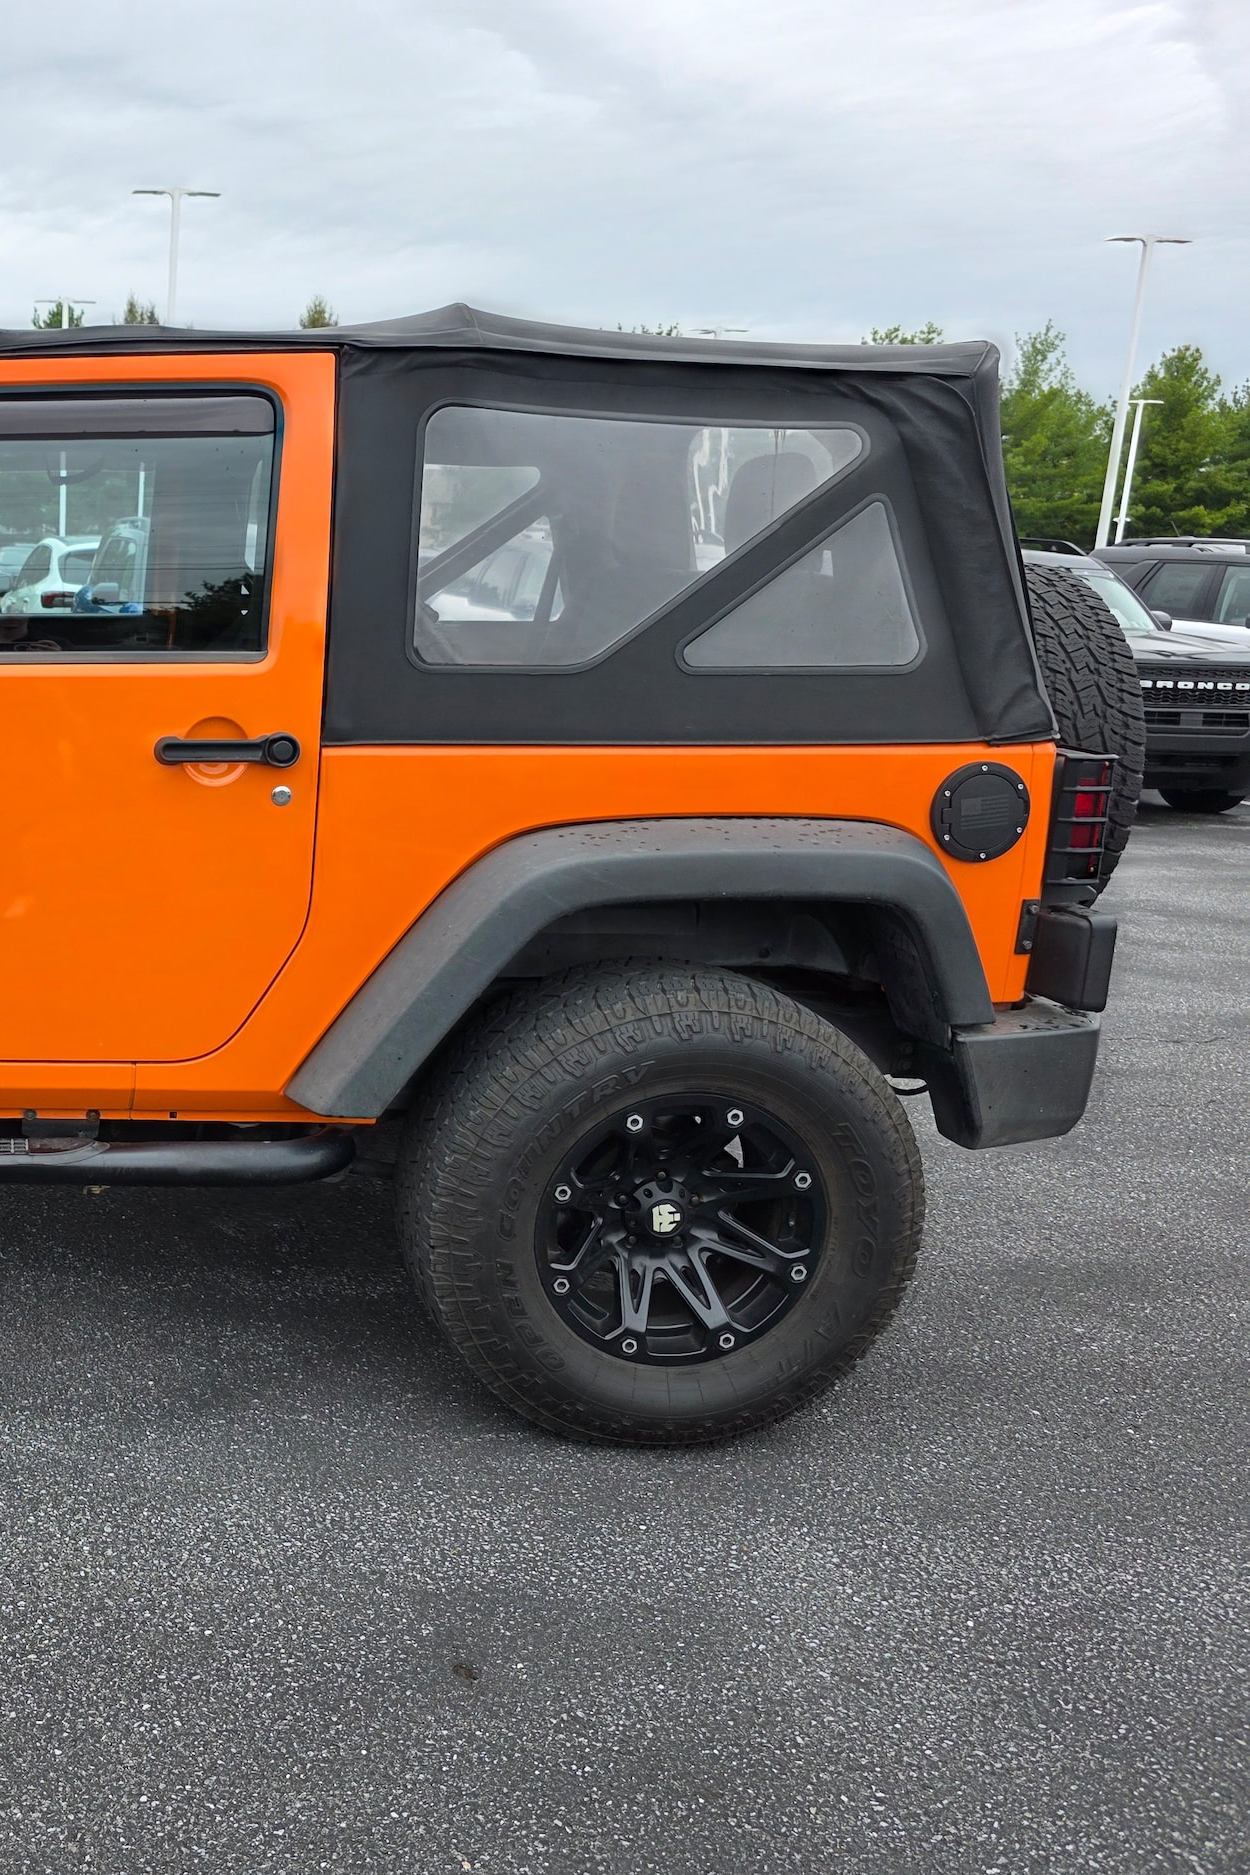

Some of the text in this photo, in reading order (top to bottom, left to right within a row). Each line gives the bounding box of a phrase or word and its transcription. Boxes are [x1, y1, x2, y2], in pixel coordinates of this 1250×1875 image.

[494, 1060, 656, 1373] OPEN COUNTRY
[831, 1121, 880, 1279] TOYO
